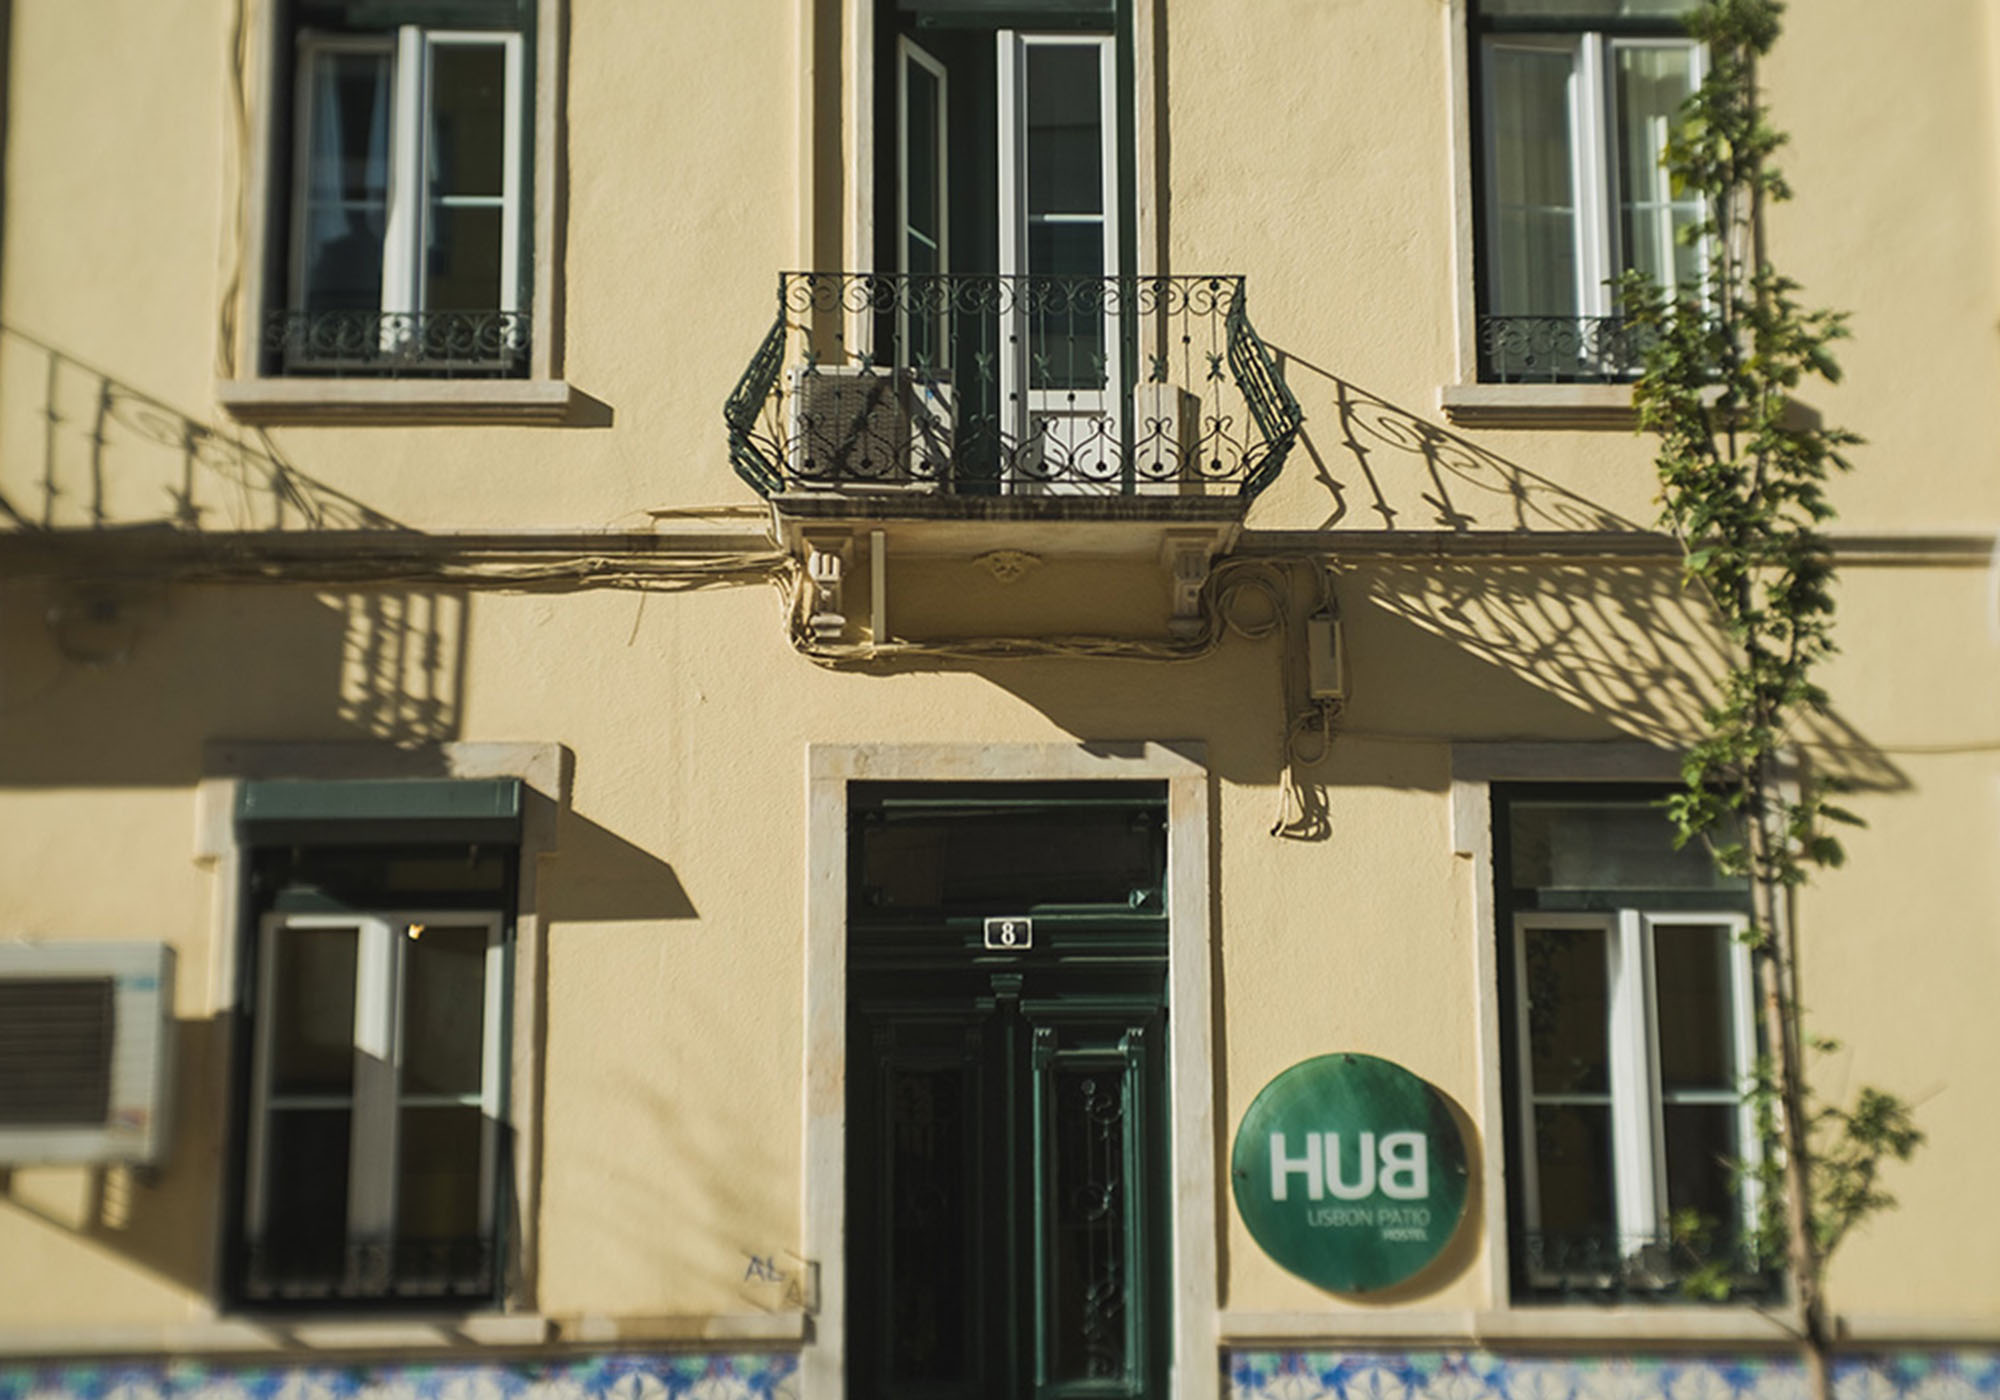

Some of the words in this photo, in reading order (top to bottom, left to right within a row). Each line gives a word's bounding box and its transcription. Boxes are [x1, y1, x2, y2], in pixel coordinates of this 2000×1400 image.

[1001, 922, 1015, 945] 8
[1270, 1132, 1429, 1200] HUB
[1307, 1208, 1373, 1227] LISBON
[1378, 1208, 1431, 1227] PATIO
[1382, 1228, 1428, 1241] HOSTEL
